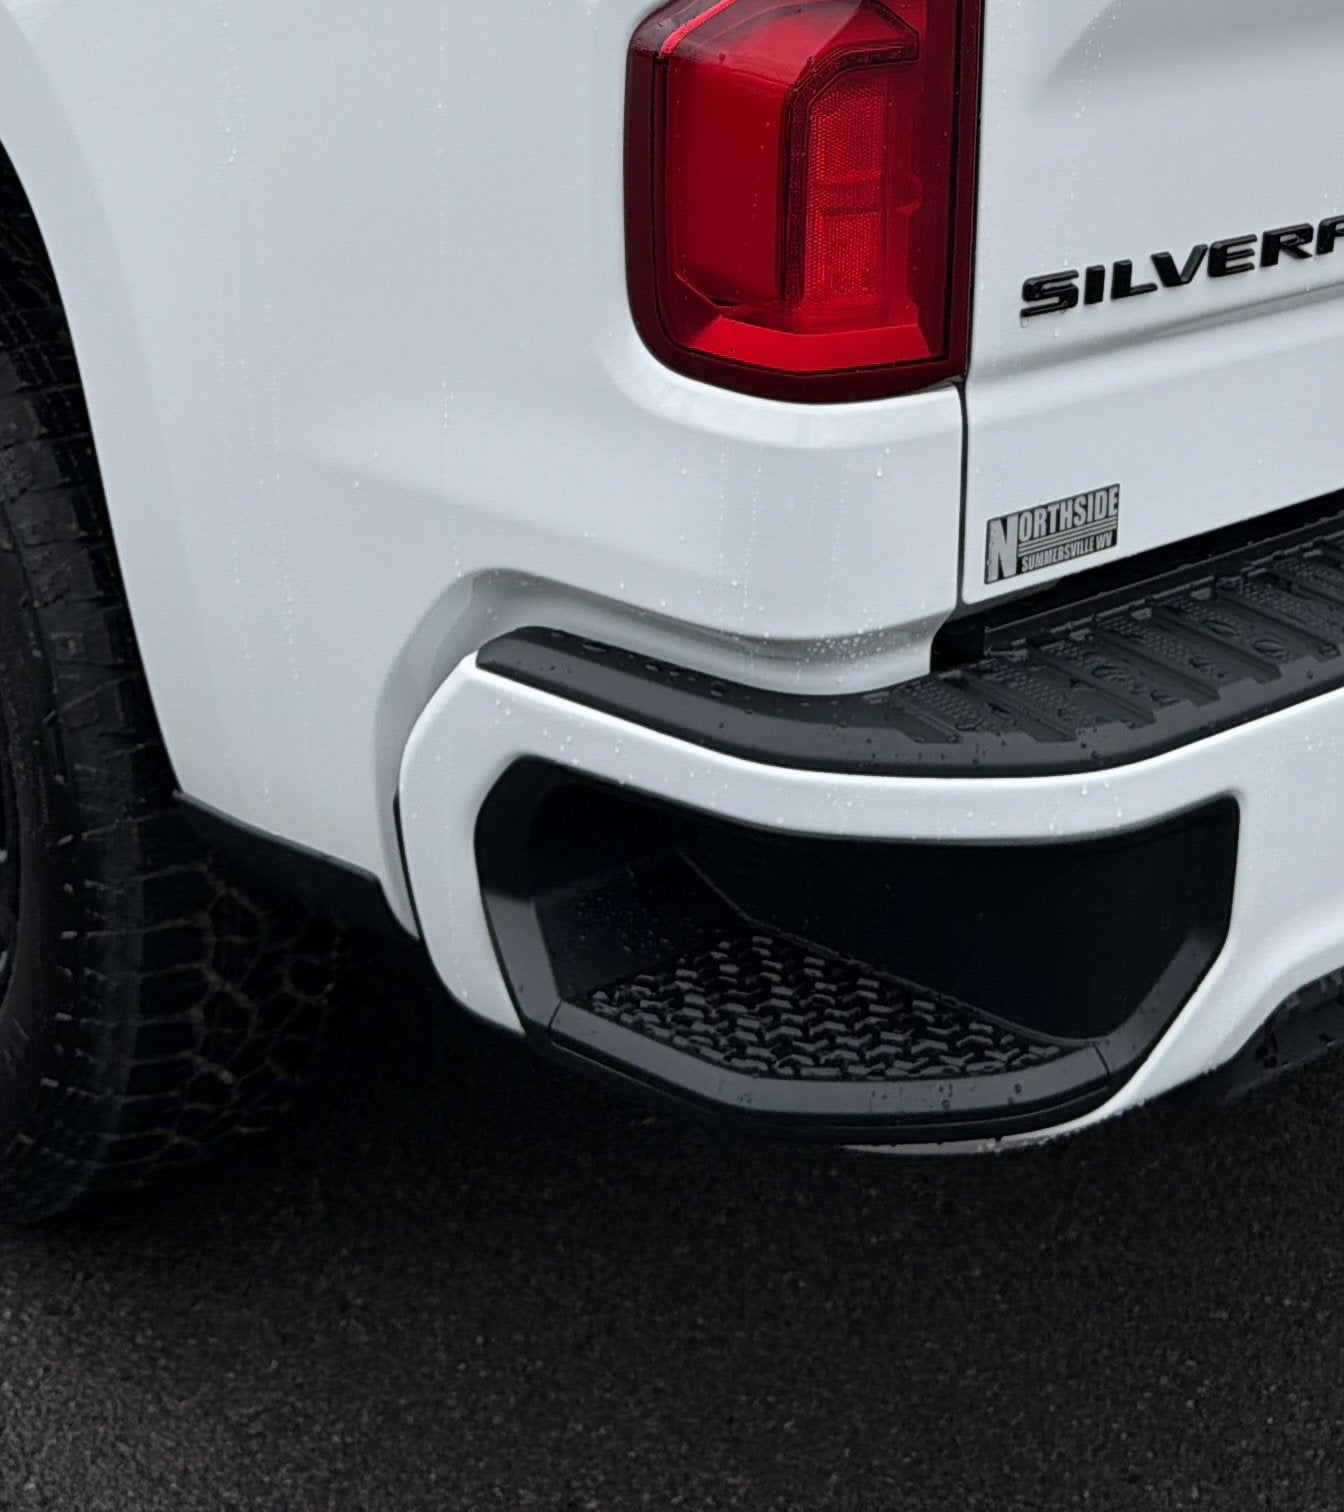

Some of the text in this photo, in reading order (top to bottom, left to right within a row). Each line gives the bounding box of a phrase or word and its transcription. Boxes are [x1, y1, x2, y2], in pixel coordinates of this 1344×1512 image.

[985, 488, 1120, 583] NORTHSIDE
[1021, 530, 1113, 573] SUMMERSVILLE WV
